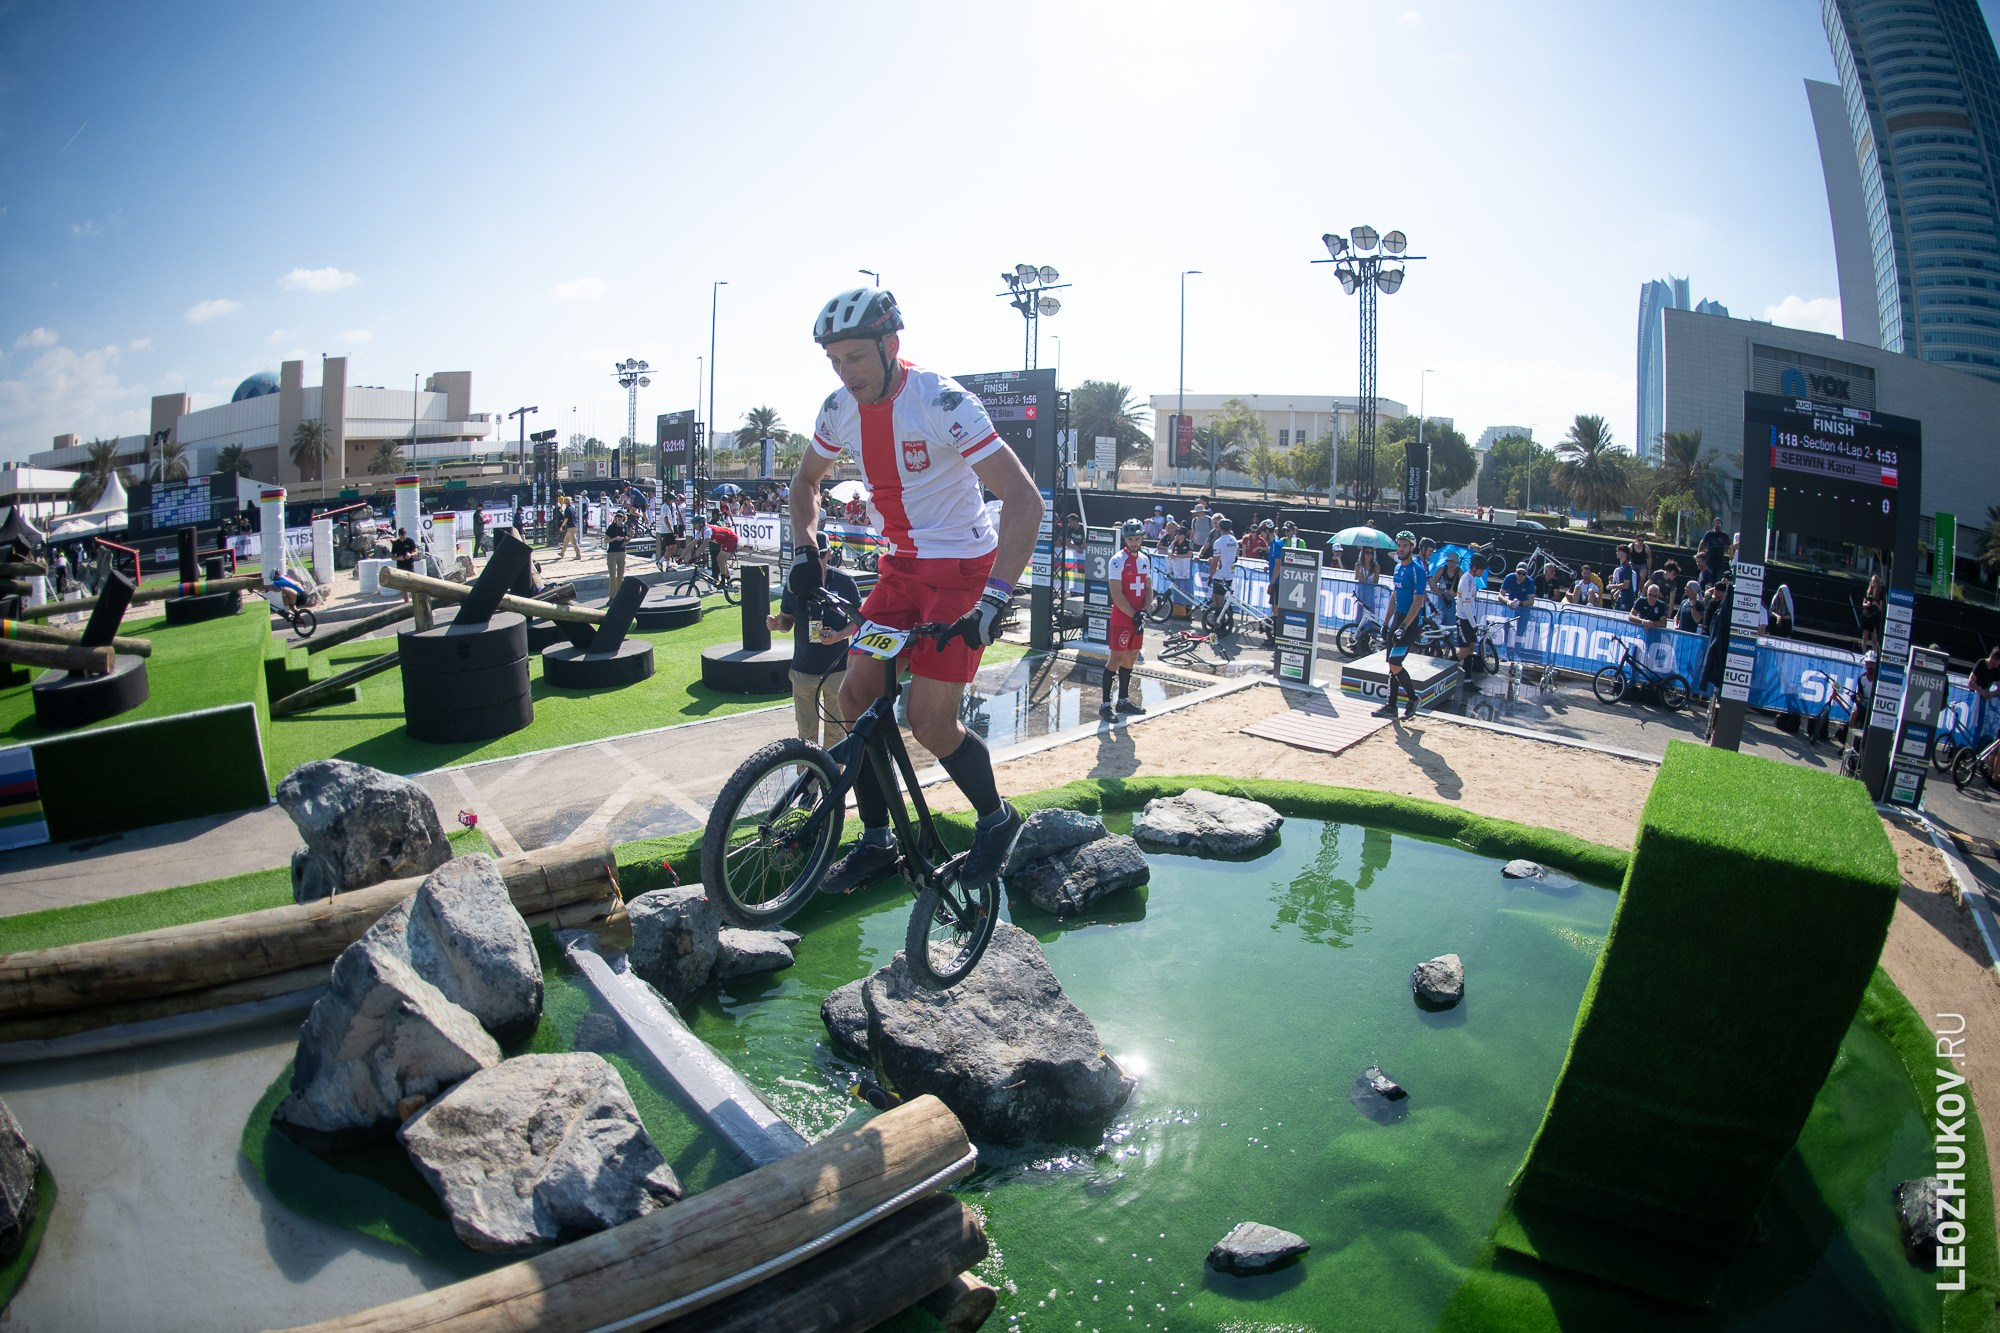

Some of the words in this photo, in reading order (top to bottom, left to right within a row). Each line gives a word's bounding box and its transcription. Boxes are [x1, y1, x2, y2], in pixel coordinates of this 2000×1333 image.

[984, 384, 1008, 392] FINISH
[1808, 373, 1850, 400] VOX
[1023, 395, 1036, 404] 1:56
[998, 409, 1014, 417] Silas
[1026, 428, 1032, 439] 0
[1813, 418, 1854, 437] FINISH
[663, 439, 685, 453] 13:21:19
[1778, 432, 1798, 446] 118
[1876, 449, 1898, 464] 1:53
[1781, 451, 1825, 470] SERWIN
[1827, 459, 1856, 475] Karol
[736, 523, 774, 540] TISSOT
[784, 526, 791, 542] 3
[1087, 545, 1114, 556] FINISH
[1937, 537, 1945, 566] DHABI
[1036, 566, 1047, 574] UCI
[1093, 556, 1106, 579] 3
[1741, 565, 1762, 577] UCI
[1283, 570, 1315, 583] START
[1288, 583, 1306, 609] 4
[1736, 600, 1757, 608] TISSOT
[1738, 628, 1750, 636] UCI
[1889, 627, 1907, 635] TISSOT
[866, 633, 892, 649] 118
[1728, 642, 1755, 651] SHIMANO
[1889, 656, 1899, 664] UCI
[1729, 673, 1749, 684] UCI
[1910, 674, 1943, 691] FINISH
[1362, 681, 1389, 699] UC
[1434, 681, 1446, 697] UCI
[1879, 700, 1896, 712] UCI
[1913, 691, 1931, 721] 4
